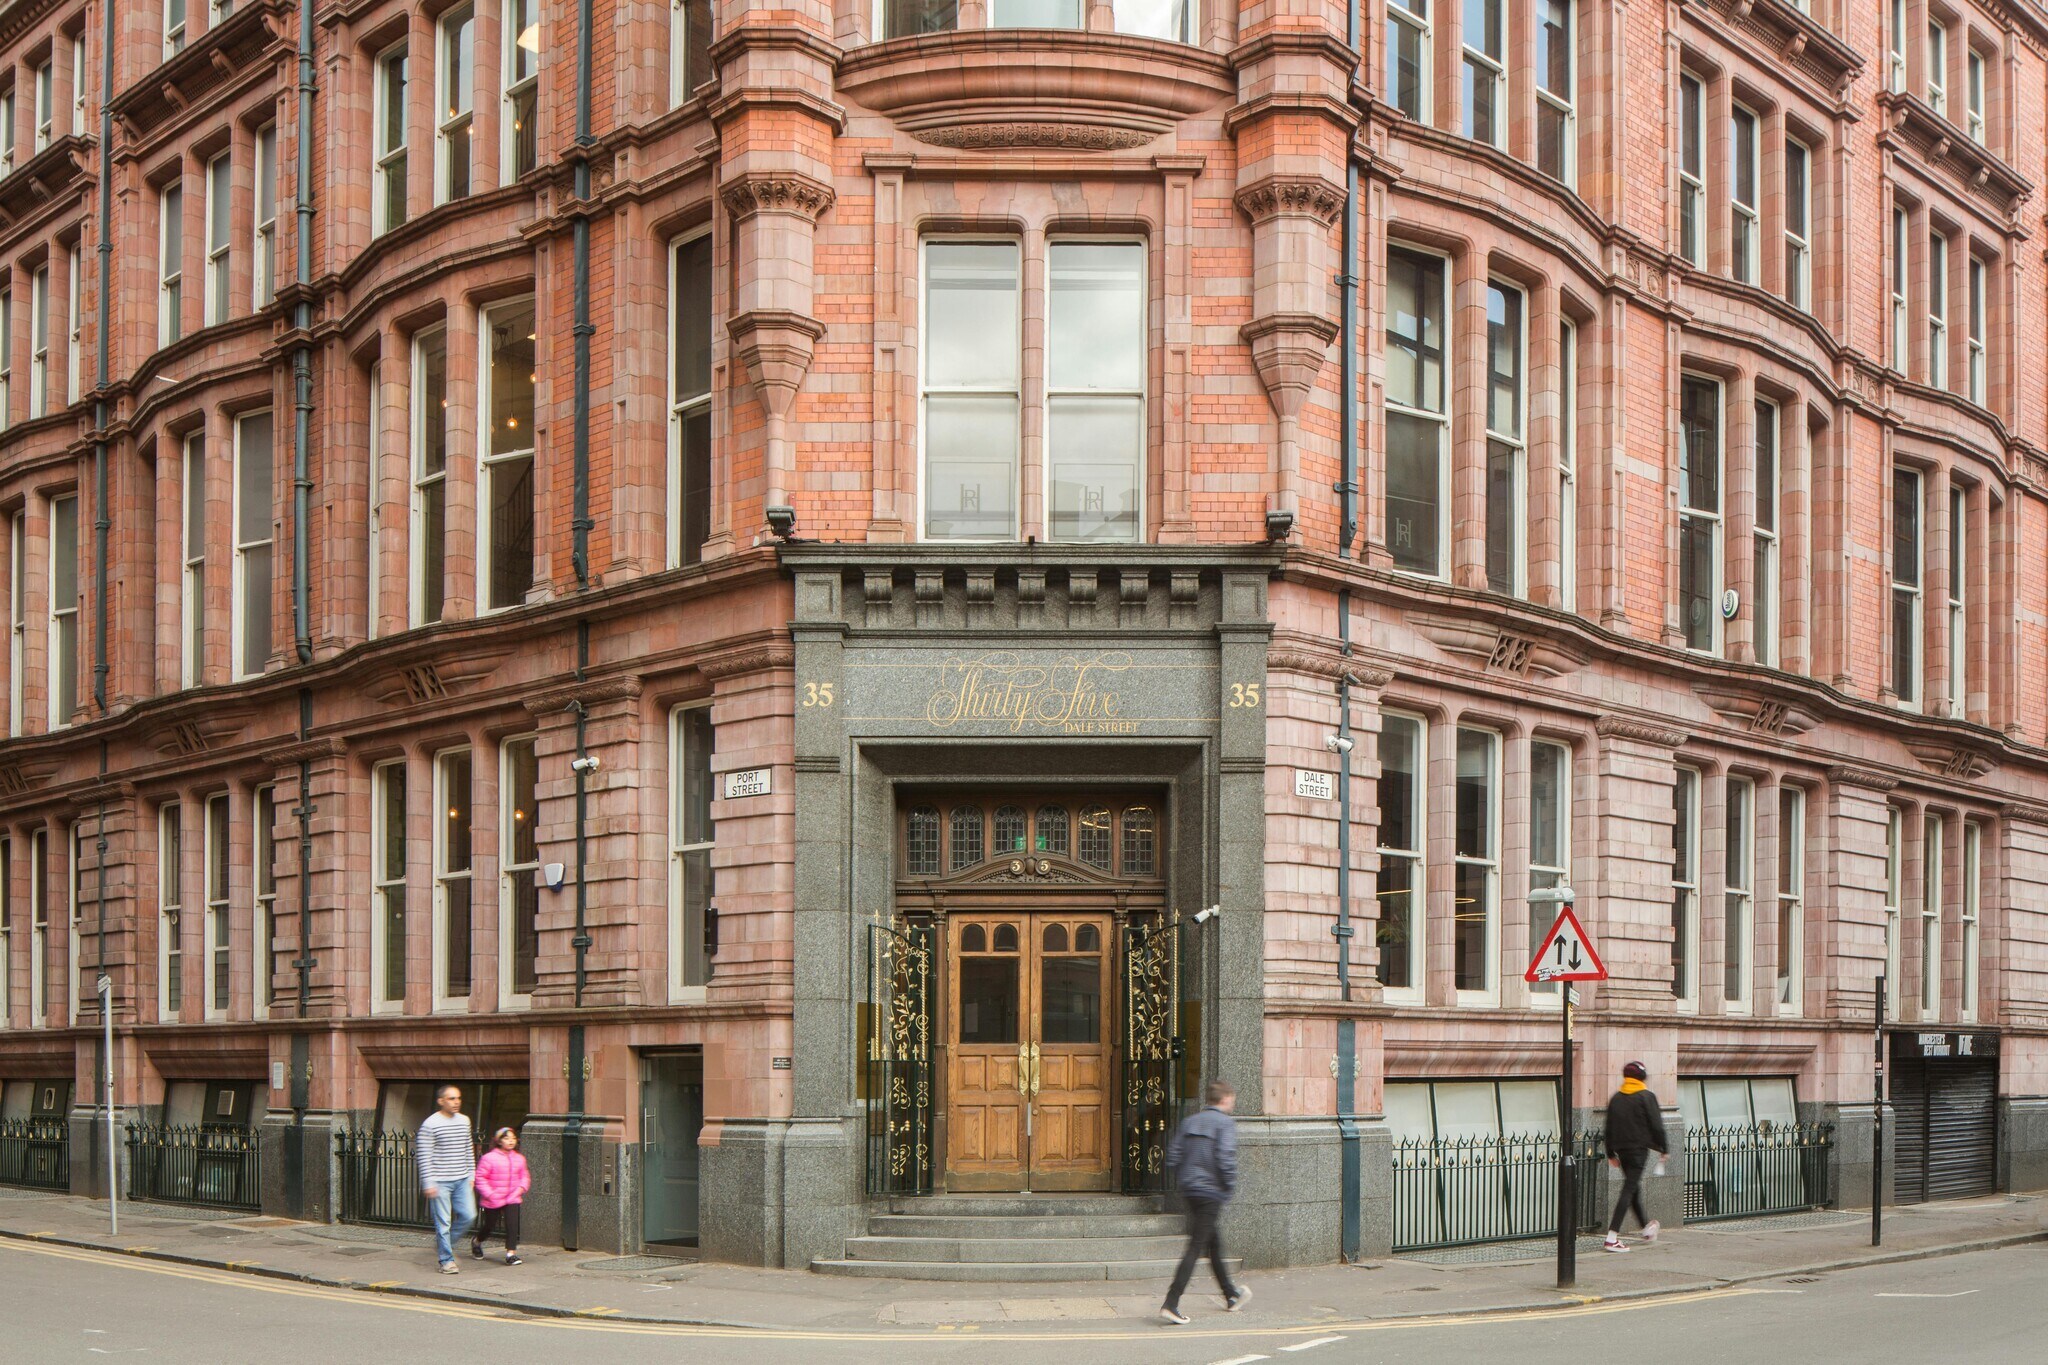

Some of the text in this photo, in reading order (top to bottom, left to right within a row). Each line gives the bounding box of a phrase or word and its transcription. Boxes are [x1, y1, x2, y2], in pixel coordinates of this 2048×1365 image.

[803, 682, 833, 707] 35
[927, 652, 1133, 732] Thirty Five
[1230, 683, 1260, 708] 35
[1064, 721, 1138, 733] DALE STREET
[737, 771, 759, 784] PORT
[1304, 771, 1325, 785] DALE
[732, 782, 764, 797] STREET
[1299, 783, 1330, 797] STREET
